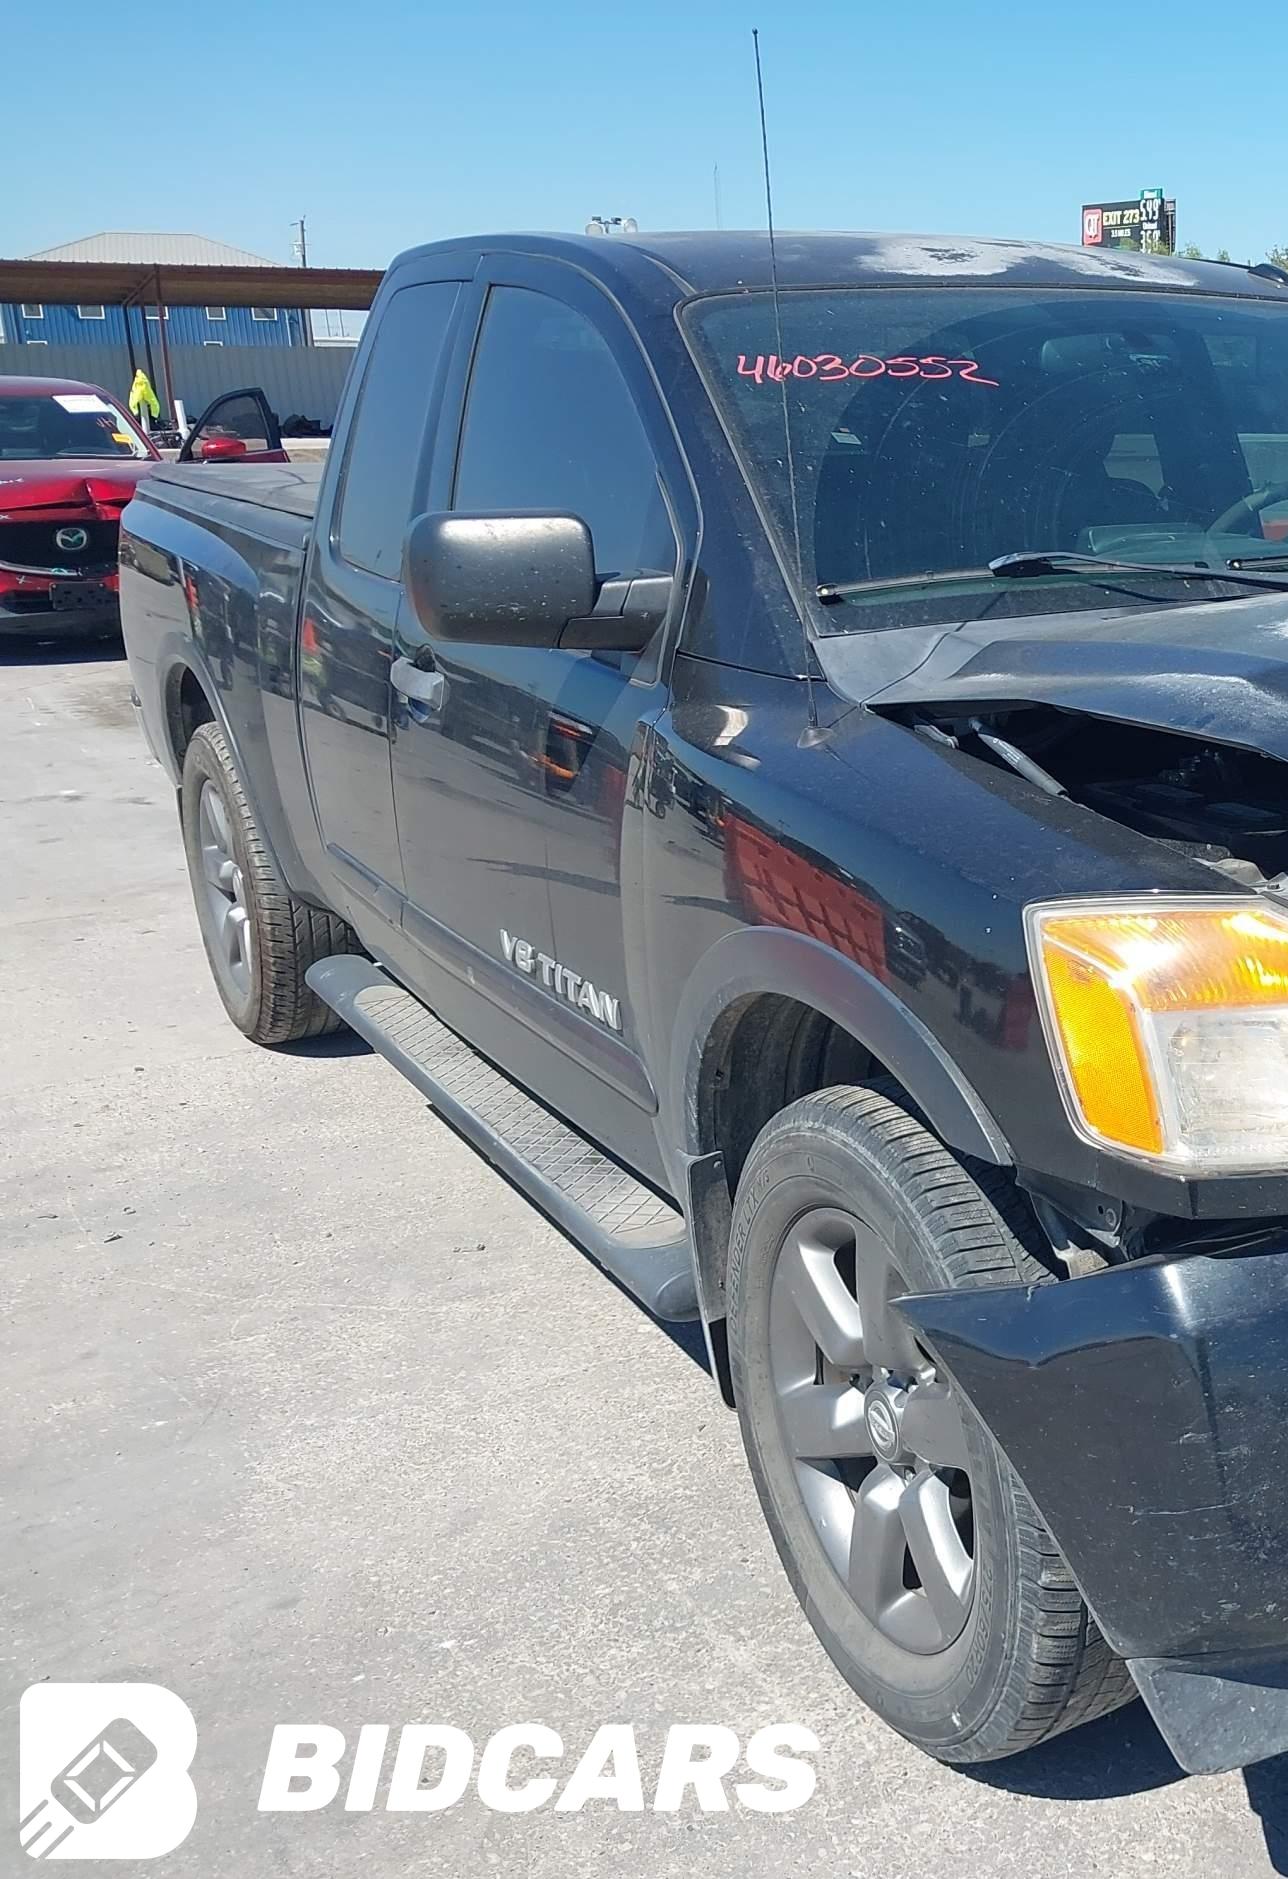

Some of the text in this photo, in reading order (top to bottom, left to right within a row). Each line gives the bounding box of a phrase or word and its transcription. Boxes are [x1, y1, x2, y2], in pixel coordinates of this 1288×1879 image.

[1103, 208, 1139, 226] EXIT 273
[737, 354, 1000, 386] 46030552
[499, 928, 623, 1031] V8 TITAN
